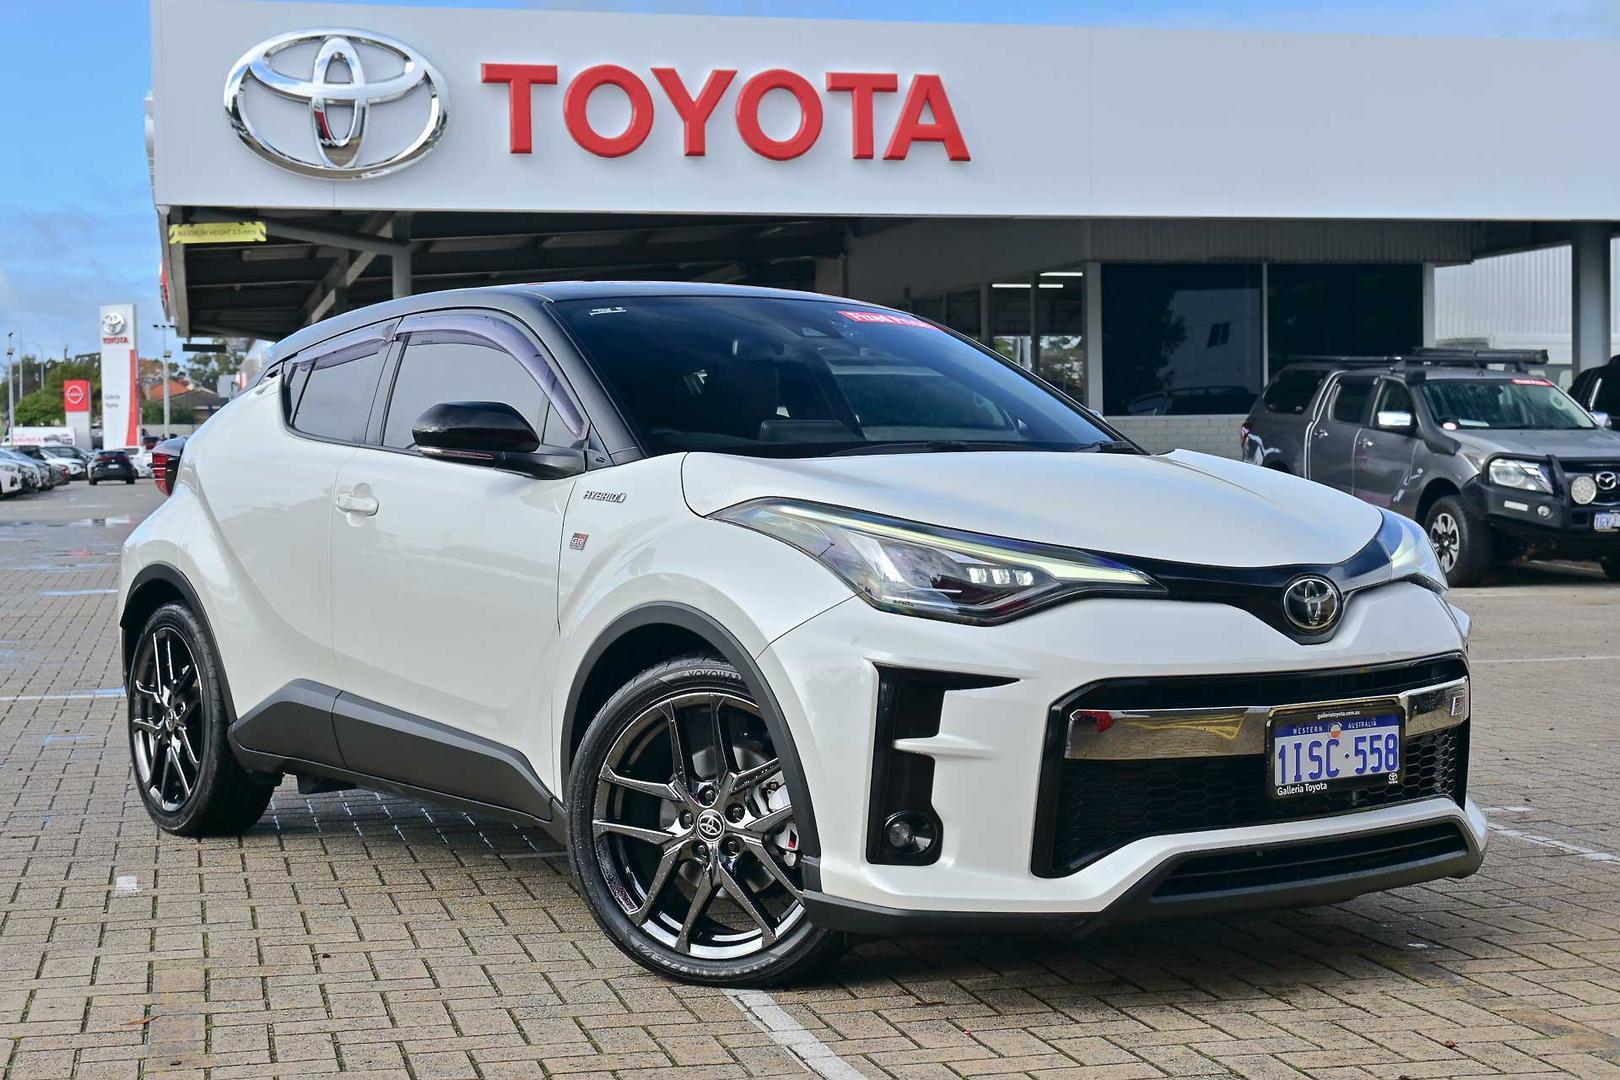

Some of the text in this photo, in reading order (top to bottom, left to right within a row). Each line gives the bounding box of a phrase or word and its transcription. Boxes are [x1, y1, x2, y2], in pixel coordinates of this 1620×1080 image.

[481, 63, 971, 161] TOYOTA
[583, 490, 623, 503] HYBRID
[1292, 719, 1377, 735] WESTERN AUSTRALIA
[1277, 782, 1328, 796] Galleria Toyota
